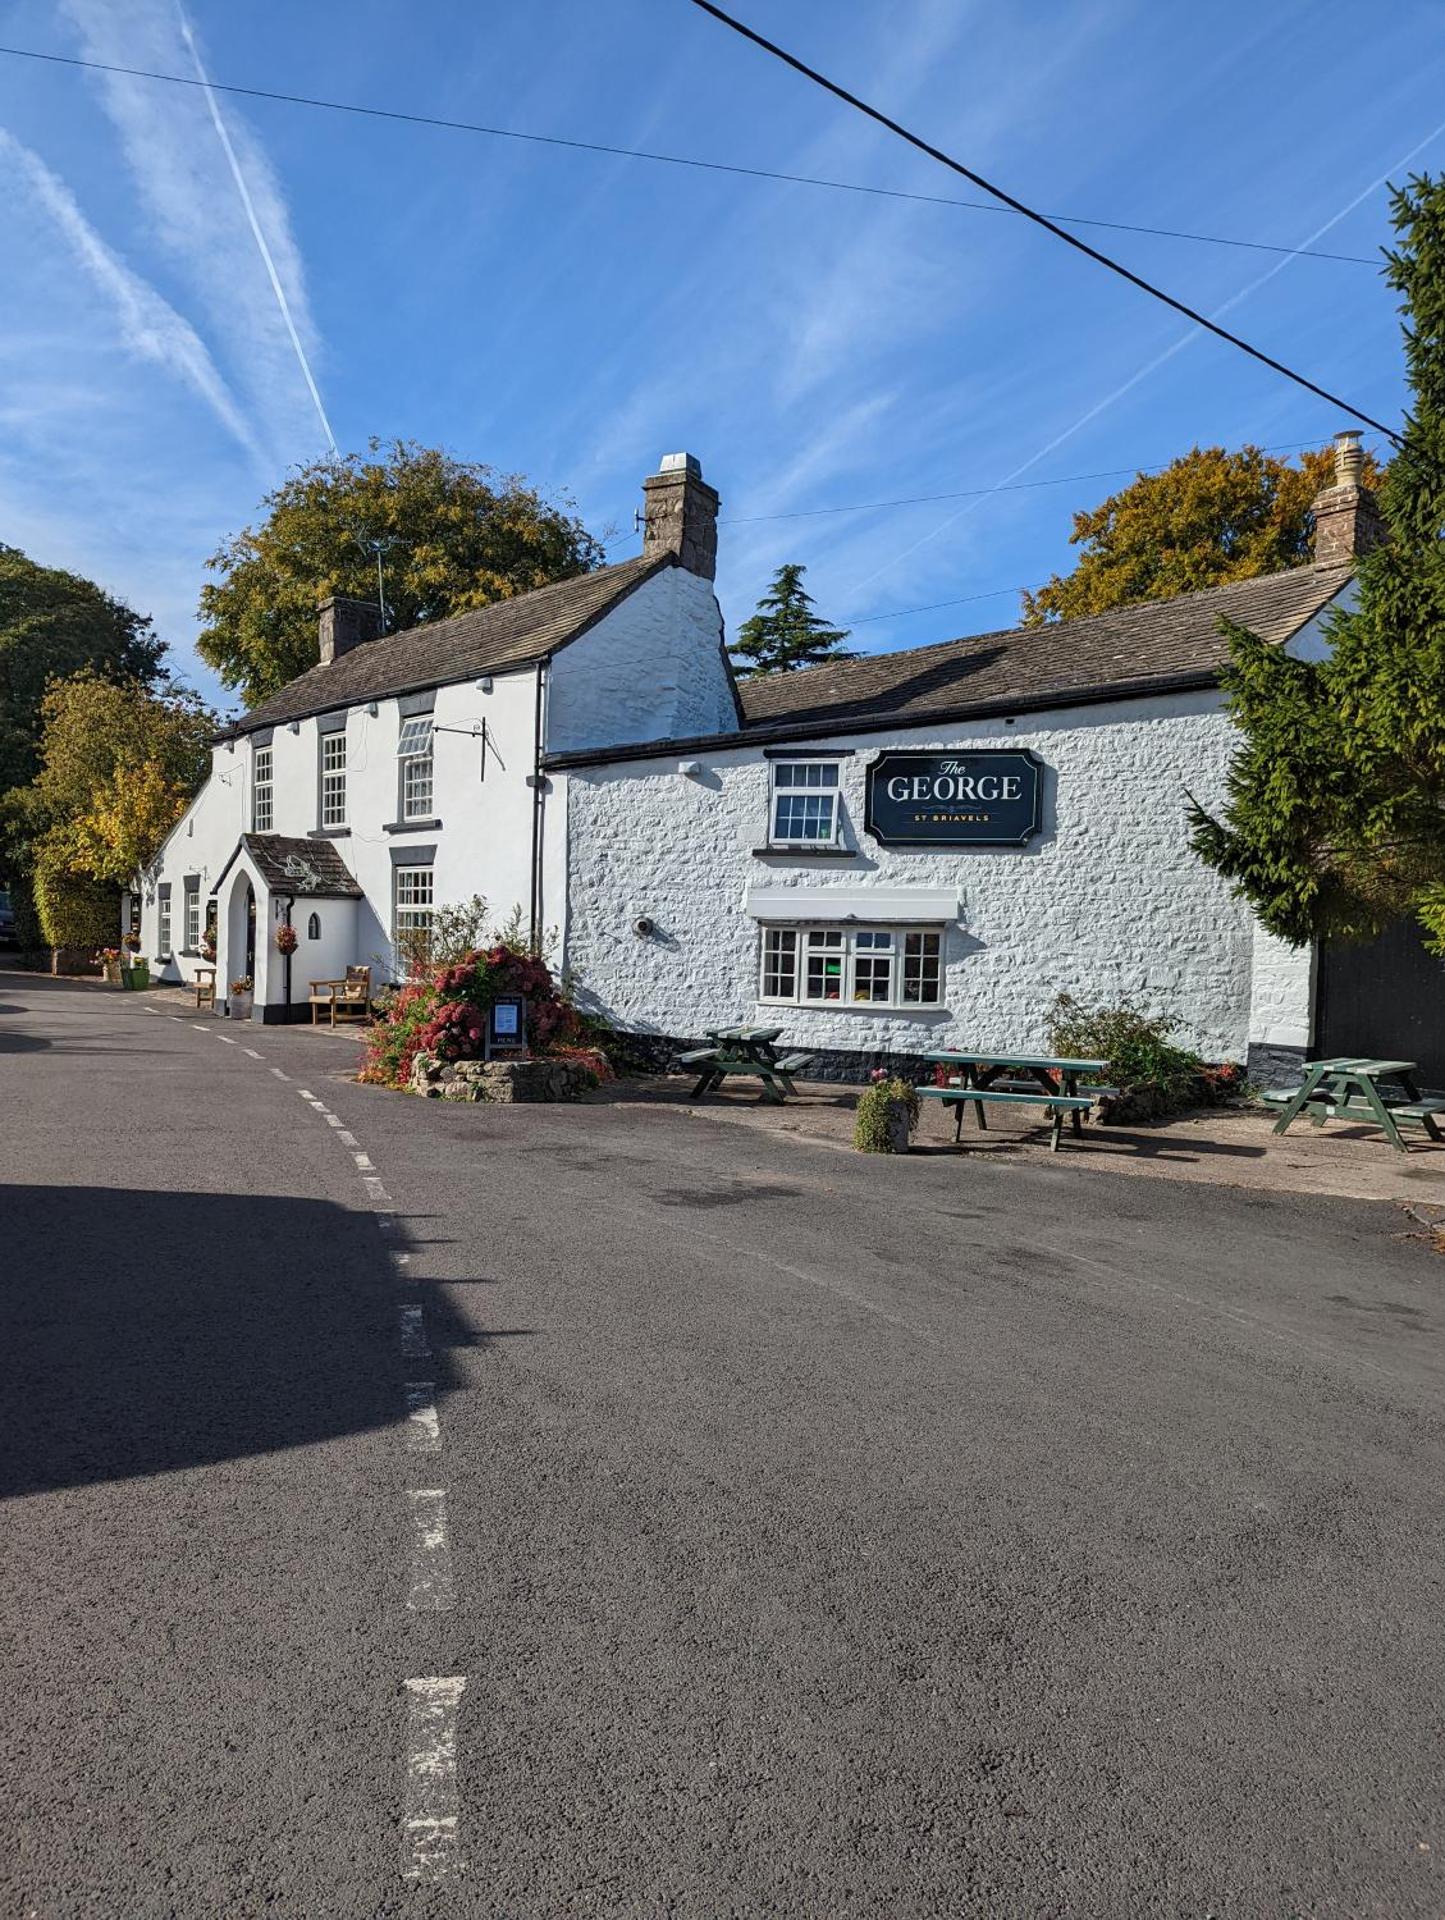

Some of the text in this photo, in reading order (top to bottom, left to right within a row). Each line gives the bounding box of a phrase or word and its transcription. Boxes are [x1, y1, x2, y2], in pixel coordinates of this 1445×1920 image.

[938, 761, 966, 775] The
[887, 776, 1022, 802] GEORGE
[914, 814, 990, 822] ST BRIAVELS
